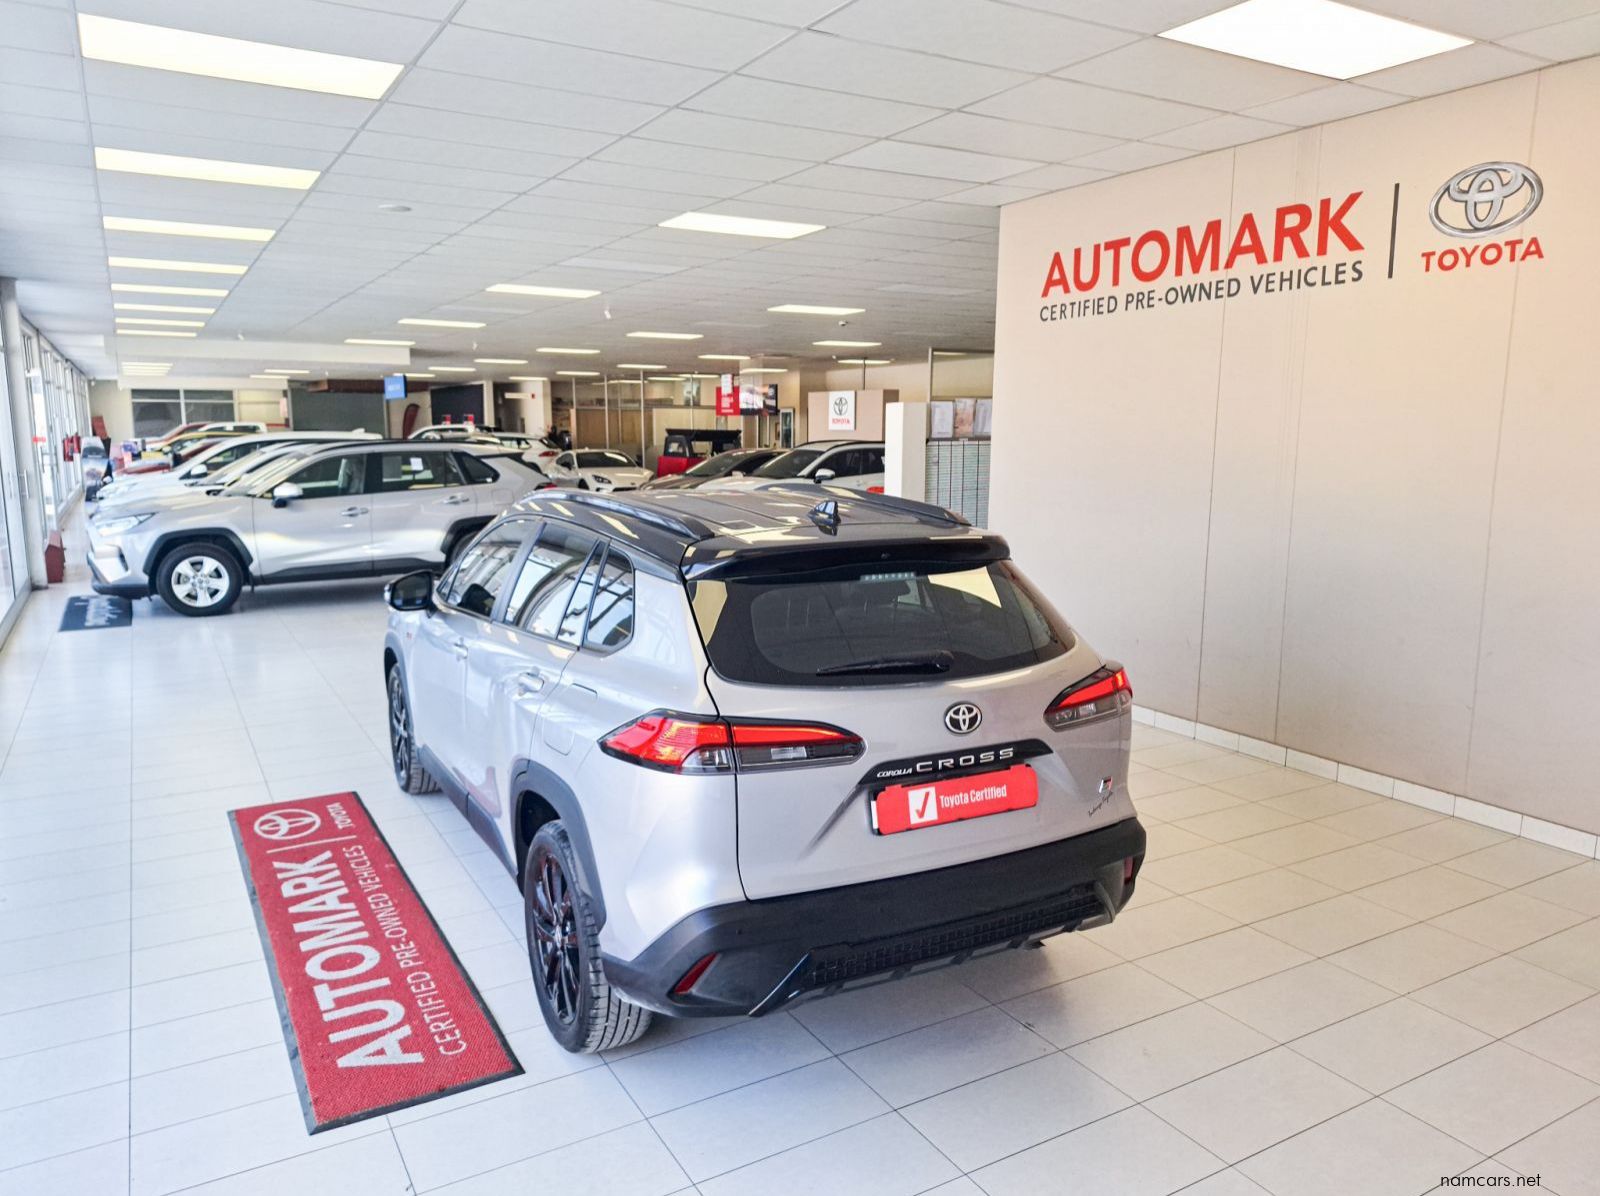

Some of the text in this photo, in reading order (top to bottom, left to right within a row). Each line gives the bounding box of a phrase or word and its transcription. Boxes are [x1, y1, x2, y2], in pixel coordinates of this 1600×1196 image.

[1041, 191, 1365, 298] AUTOMARK
[1421, 237, 1544, 273] TOYOTA
[1040, 260, 1363, 322] CERTIFIED PRE-OWNED VEHICLES
[876, 747, 1014, 778] COROLLA CROSS
[326, 802, 355, 829] TOYOTA
[939, 784, 1007, 808] Toyota Certified
[272, 849, 425, 1068] AUTOMARK
[342, 844, 467, 1056] CERTIFIED PRE-OWNED VEHICLES
